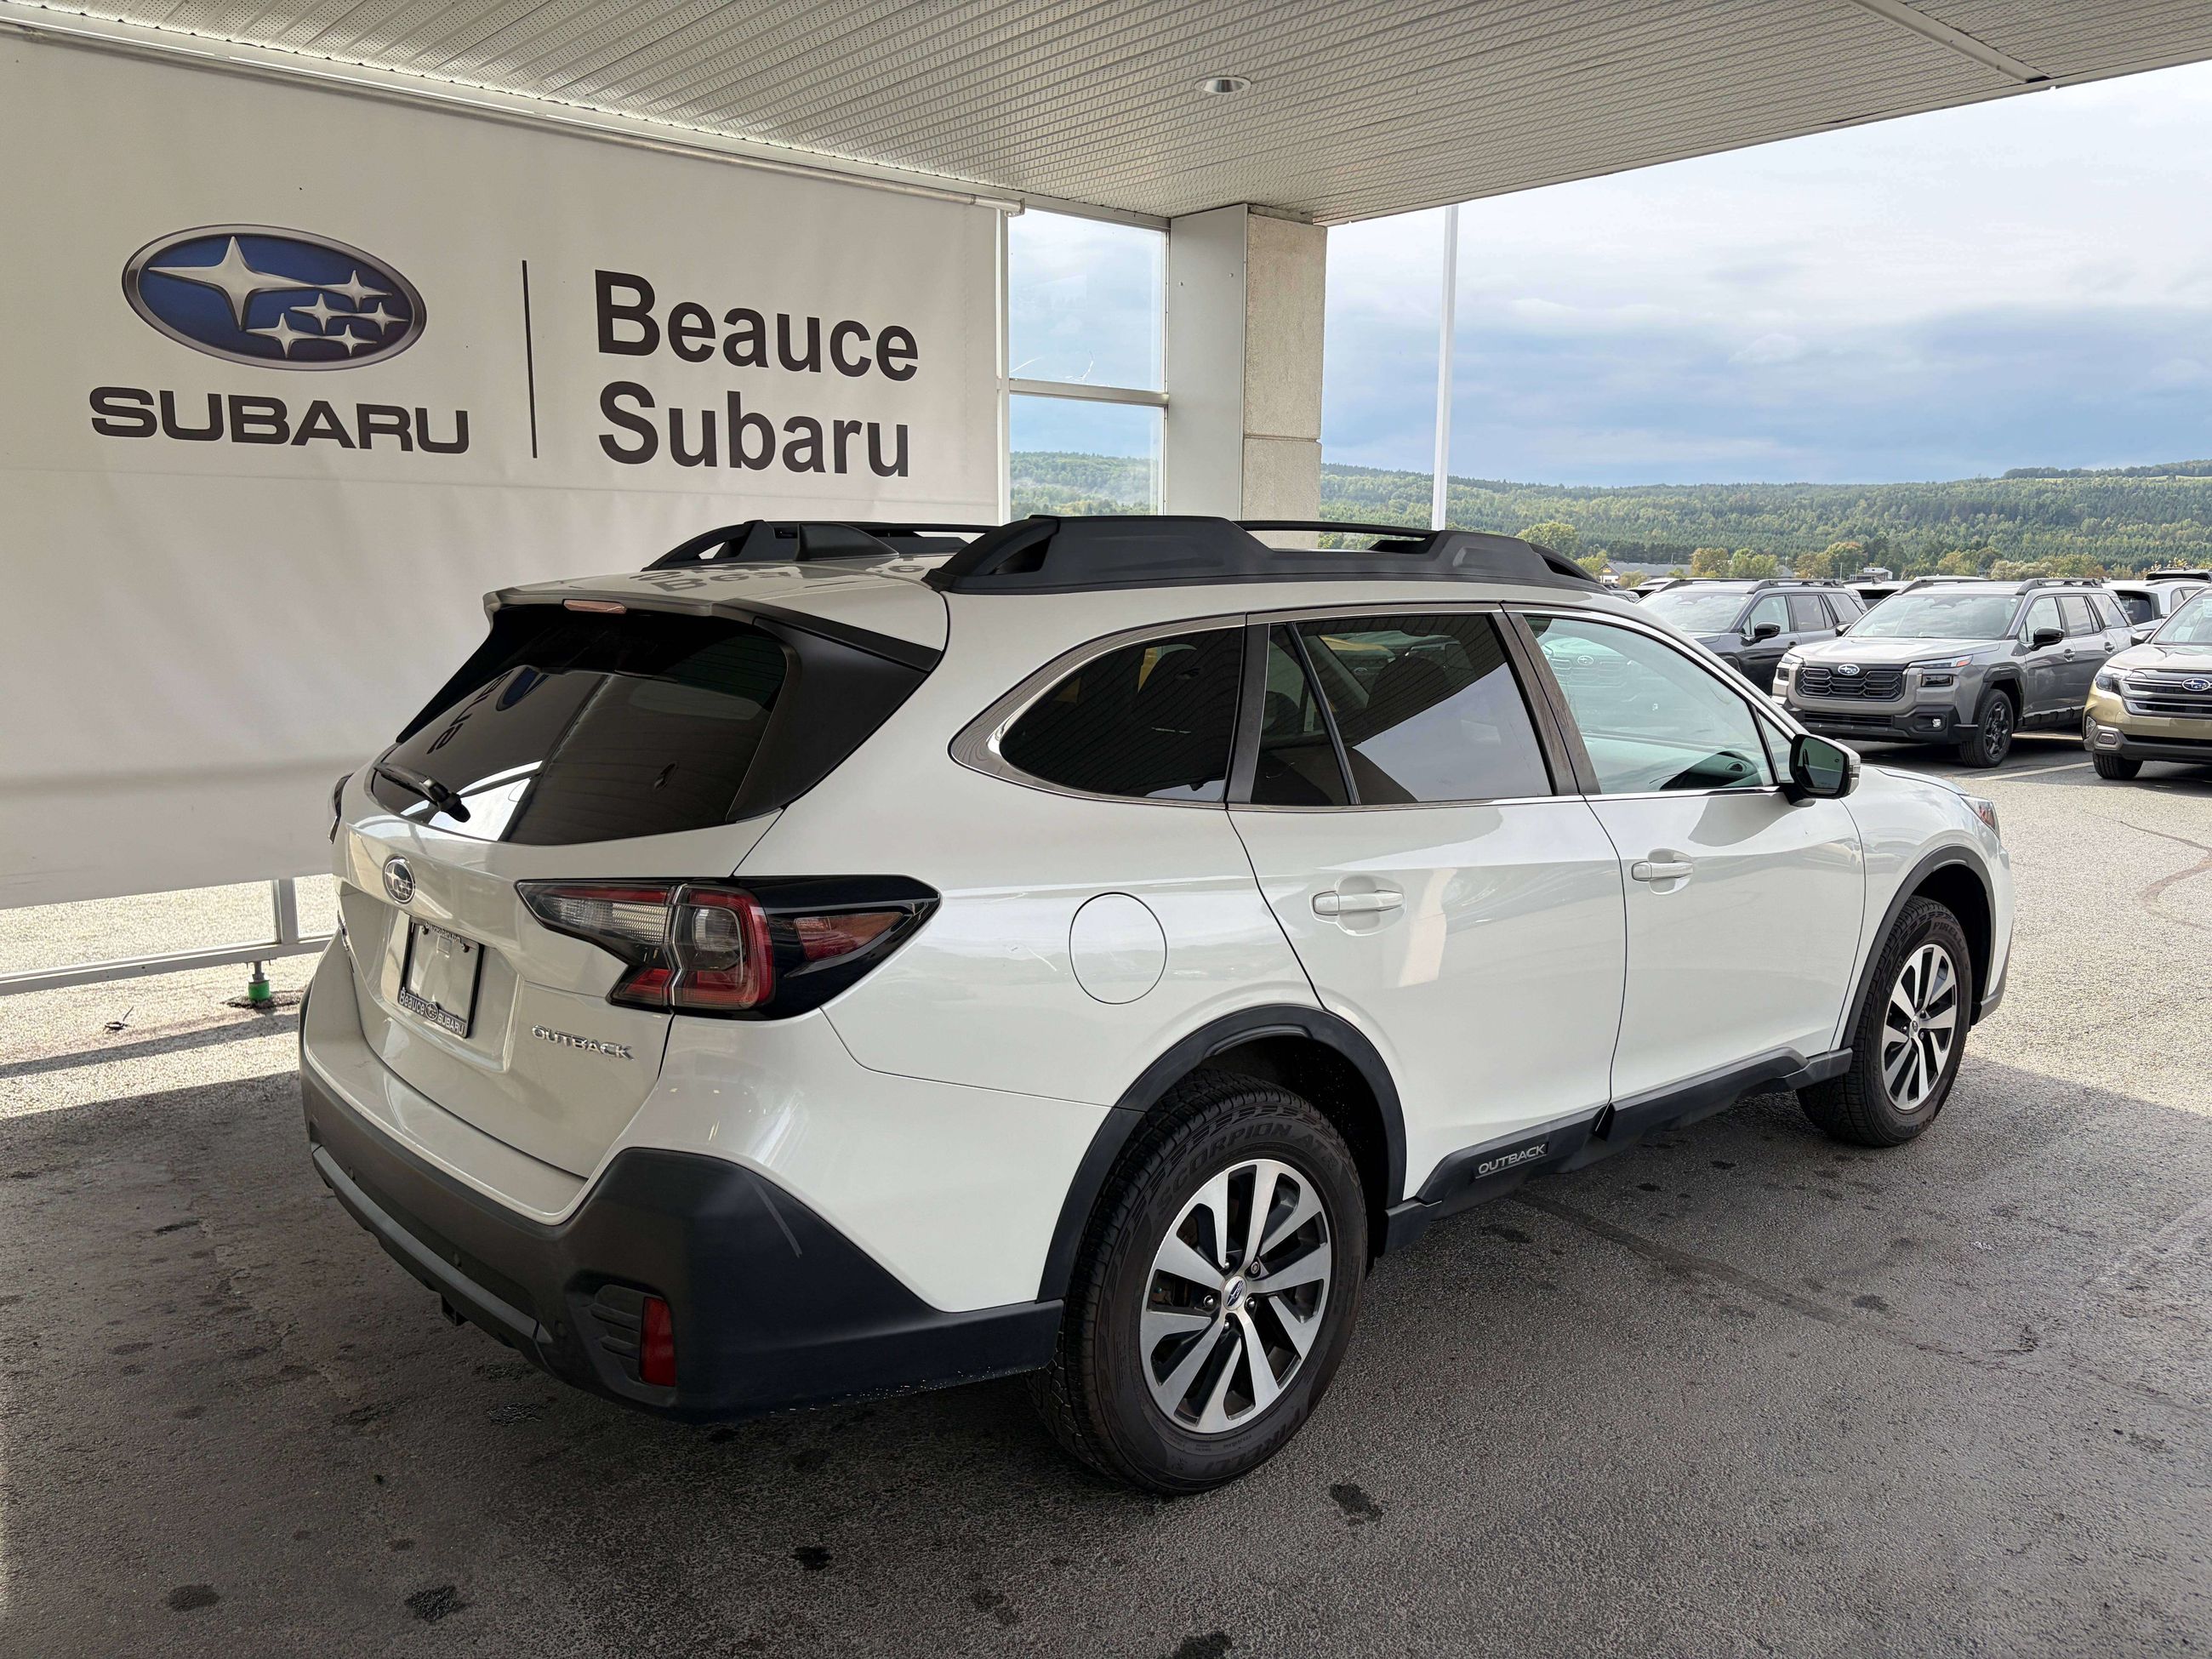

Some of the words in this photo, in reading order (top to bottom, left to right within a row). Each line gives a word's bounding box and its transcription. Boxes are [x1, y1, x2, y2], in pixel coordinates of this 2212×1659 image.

[595, 270, 919, 382] Beauce
[89, 387, 470, 454] SUBARU
[599, 381, 909, 477] Subaru
[1933, 921, 1965, 951] PIRELLI
[399, 989, 425, 1016] Beauce
[437, 1015, 465, 1035] SUBARU
[531, 1024, 635, 1061] OUTBACK
[1156, 1122, 1292, 1212] SCORPION
[1479, 1143, 1546, 1175] OUTBACK
